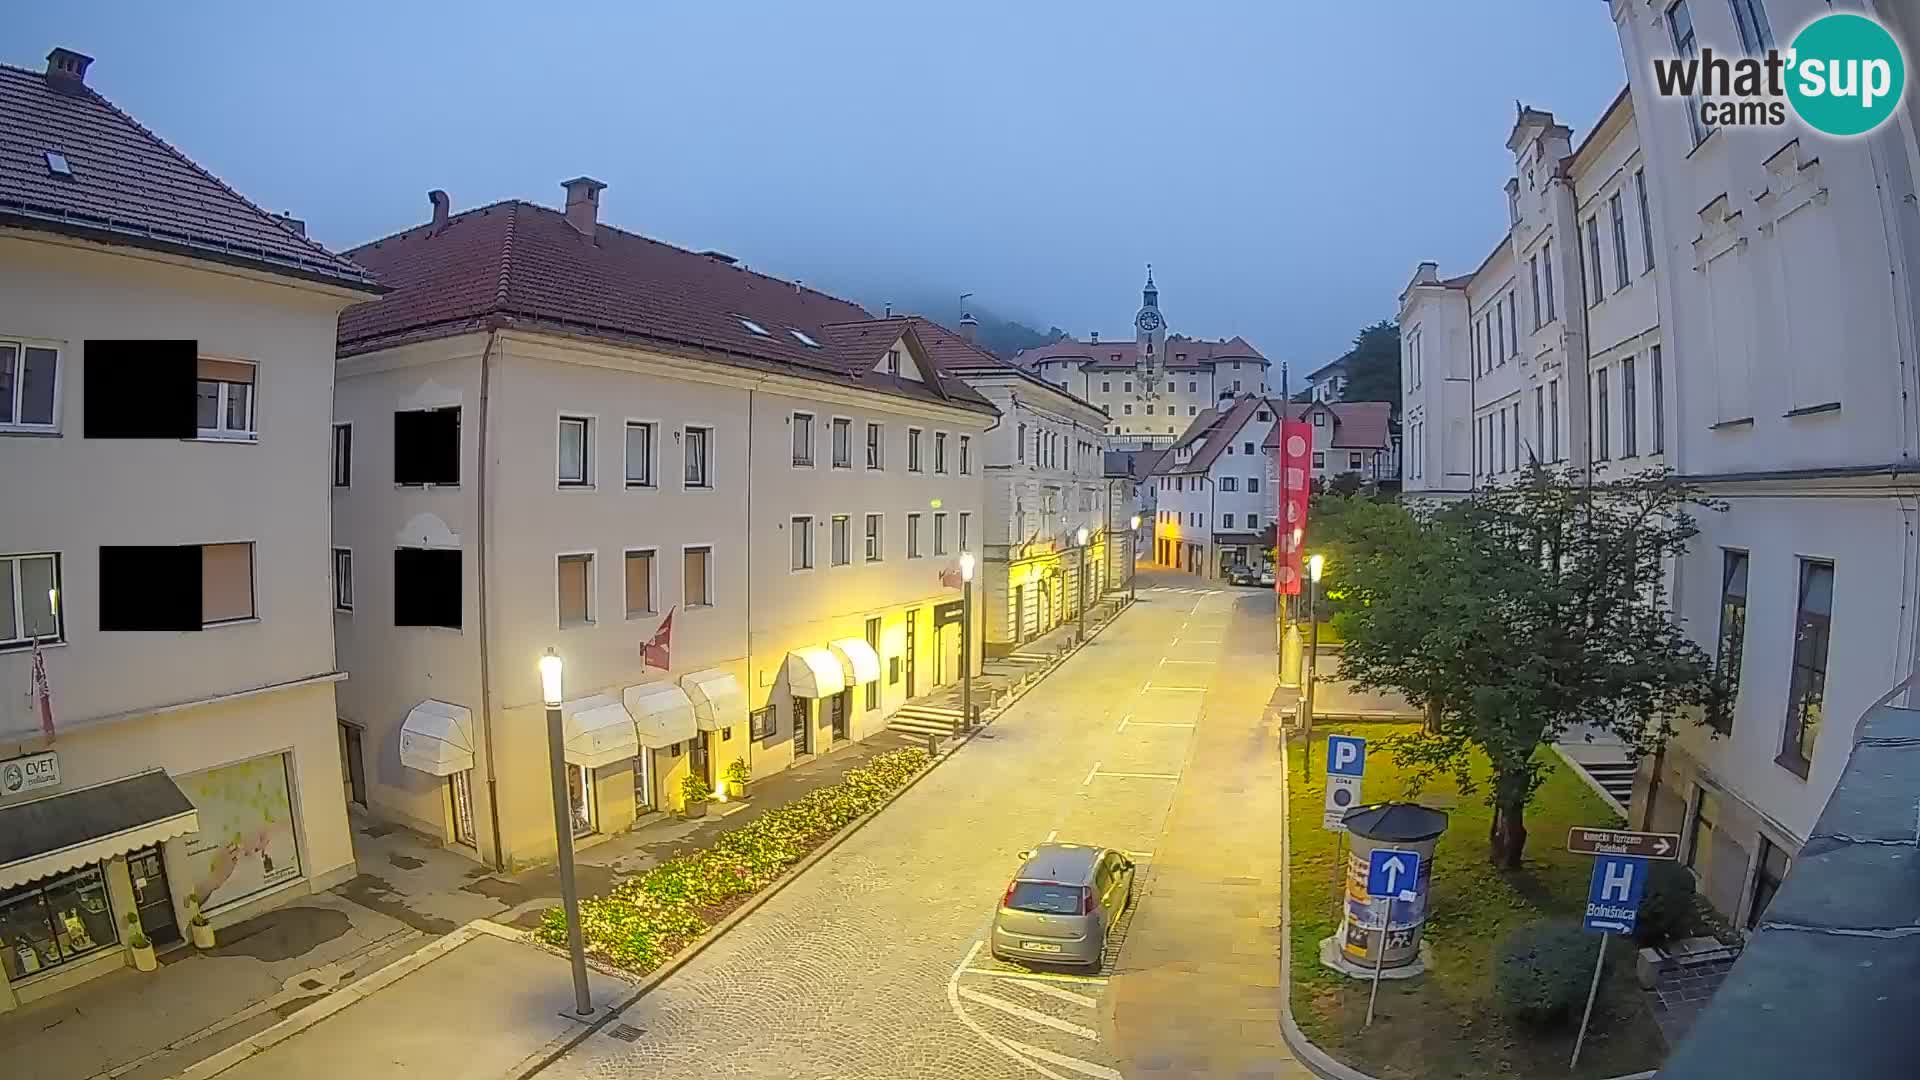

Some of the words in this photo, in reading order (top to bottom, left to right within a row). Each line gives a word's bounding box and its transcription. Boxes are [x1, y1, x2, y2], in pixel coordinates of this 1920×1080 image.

[25, 758, 54, 775] CVET
[1335, 741, 1357, 770] P
[1601, 861, 1634, 902] H
[1587, 903, 1638, 920] Bolnišnica
